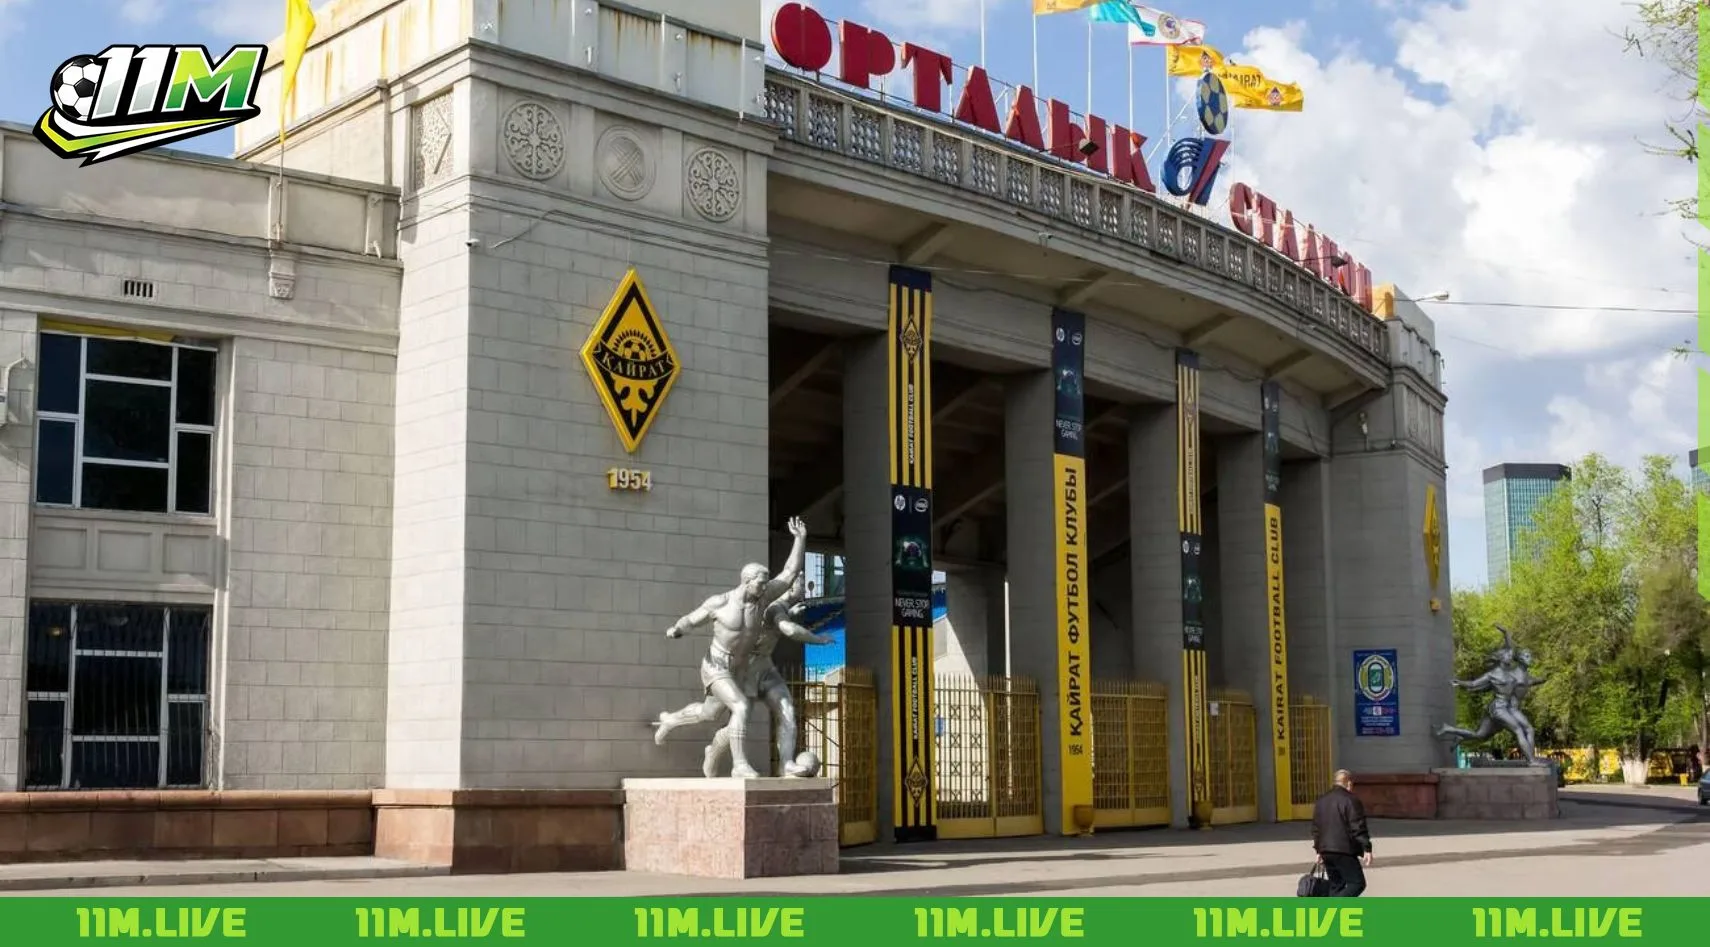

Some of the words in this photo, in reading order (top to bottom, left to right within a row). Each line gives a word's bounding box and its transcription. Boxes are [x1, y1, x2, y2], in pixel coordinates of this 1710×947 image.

[602, 353, 666, 378] КАЙРАТ
[608, 467, 653, 491] 1954
[1065, 467, 1078, 546] КЛУБЫ
[1270, 517, 1280, 564] CLUB
[1066, 551, 1080, 645] ФУТБОЛ
[1273, 571, 1282, 665] FOOTBALL
[1067, 651, 1083, 737] ҚАЙРАТ
[1276, 671, 1285, 740] KAIRAT
